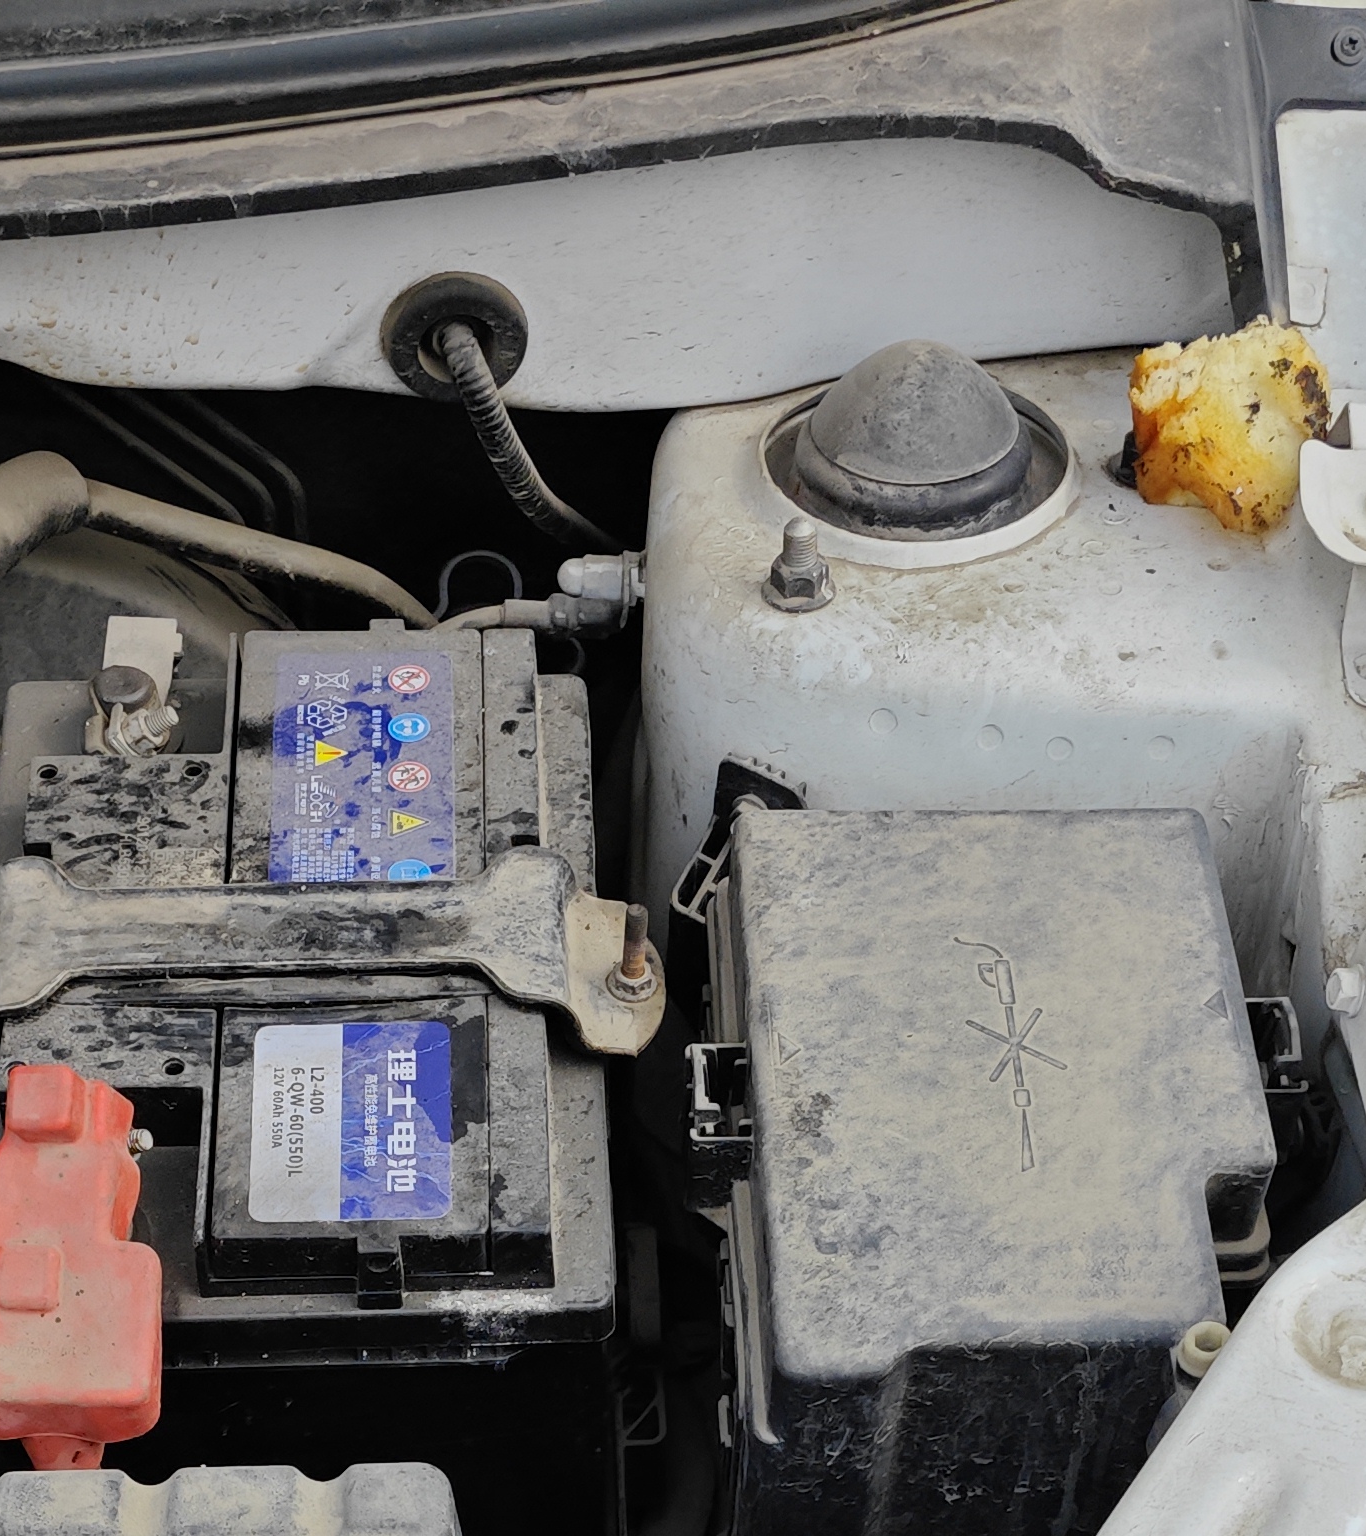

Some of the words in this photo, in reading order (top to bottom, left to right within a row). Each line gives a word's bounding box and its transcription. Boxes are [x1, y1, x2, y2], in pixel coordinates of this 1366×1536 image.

[297, 674, 310, 686] Pb
[273, 1067, 284, 1087] 12V
[310, 1066, 325, 1115] L2-400
[272, 1091, 284, 1118] 60Ah
[286, 1067, 306, 1178] 6-QW-60(550)L
[386, 1049, 417, 1193] 理士电池
[271, 1122, 283, 1149] 550A
